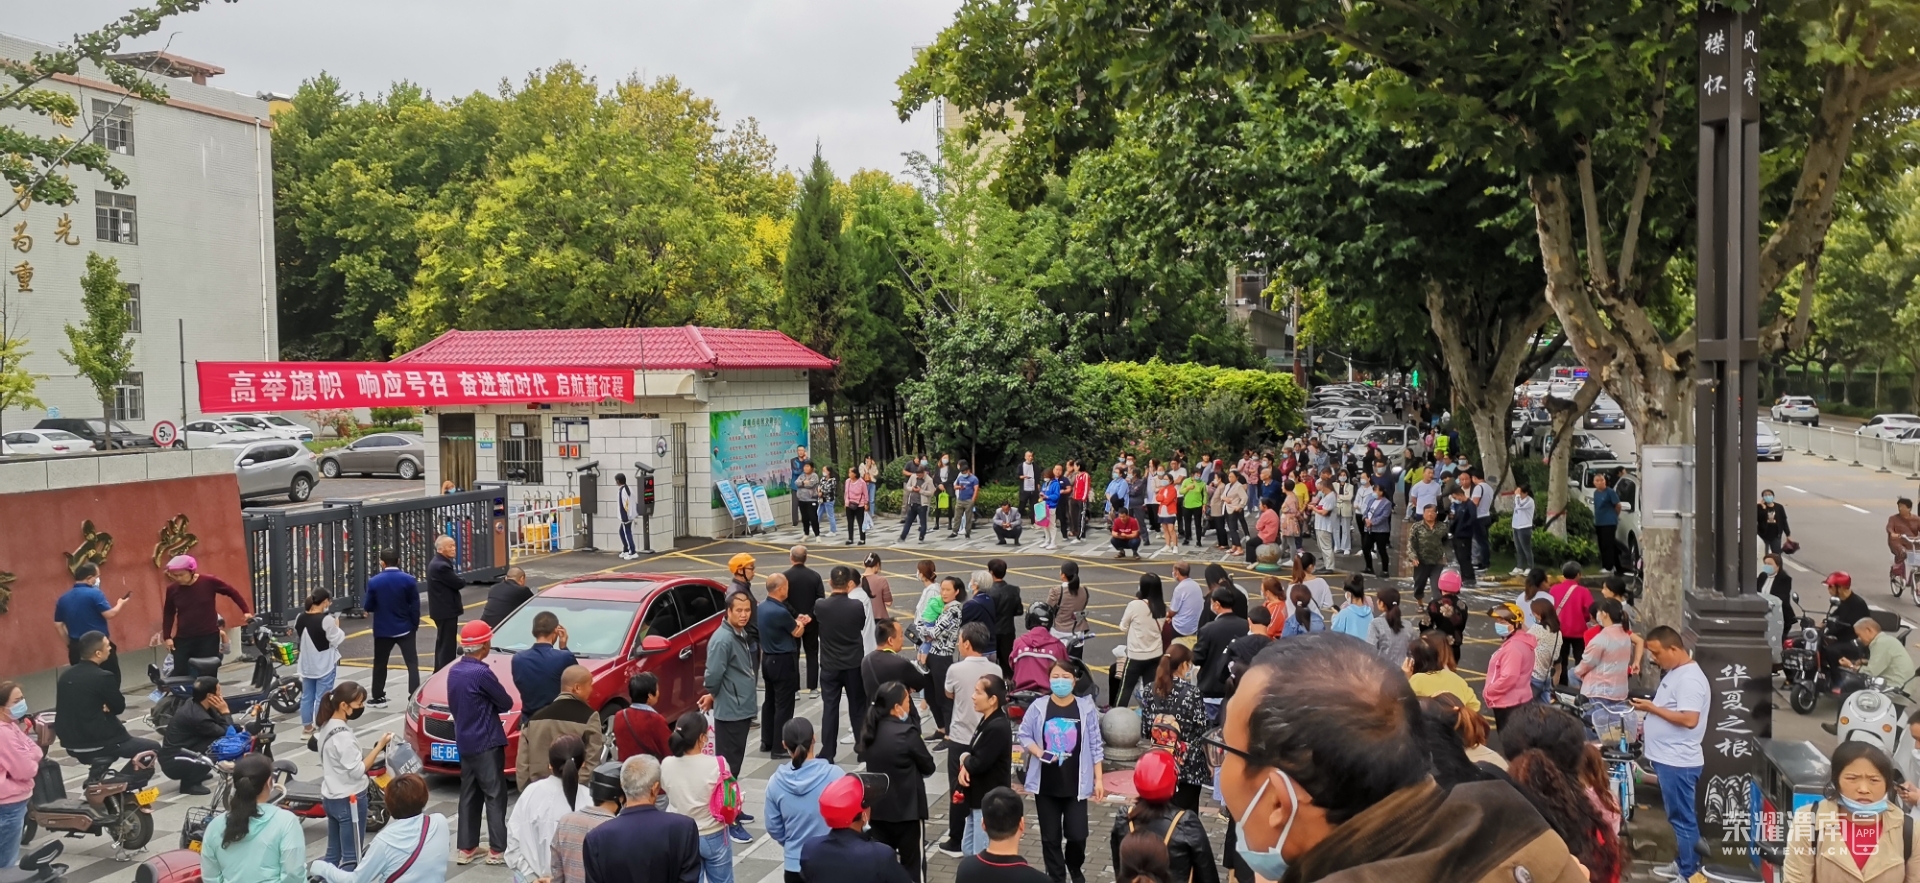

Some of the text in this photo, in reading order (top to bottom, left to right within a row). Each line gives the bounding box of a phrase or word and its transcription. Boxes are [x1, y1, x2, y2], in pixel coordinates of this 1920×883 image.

[1743, 0, 1758, 97] 风骨
[228, 370, 624, 403] 高举旗帜 响应号召 奋进新时代 启航新征程
[158, 426, 166, 438] 5
[1715, 663, 1752, 758] 华夏之根
